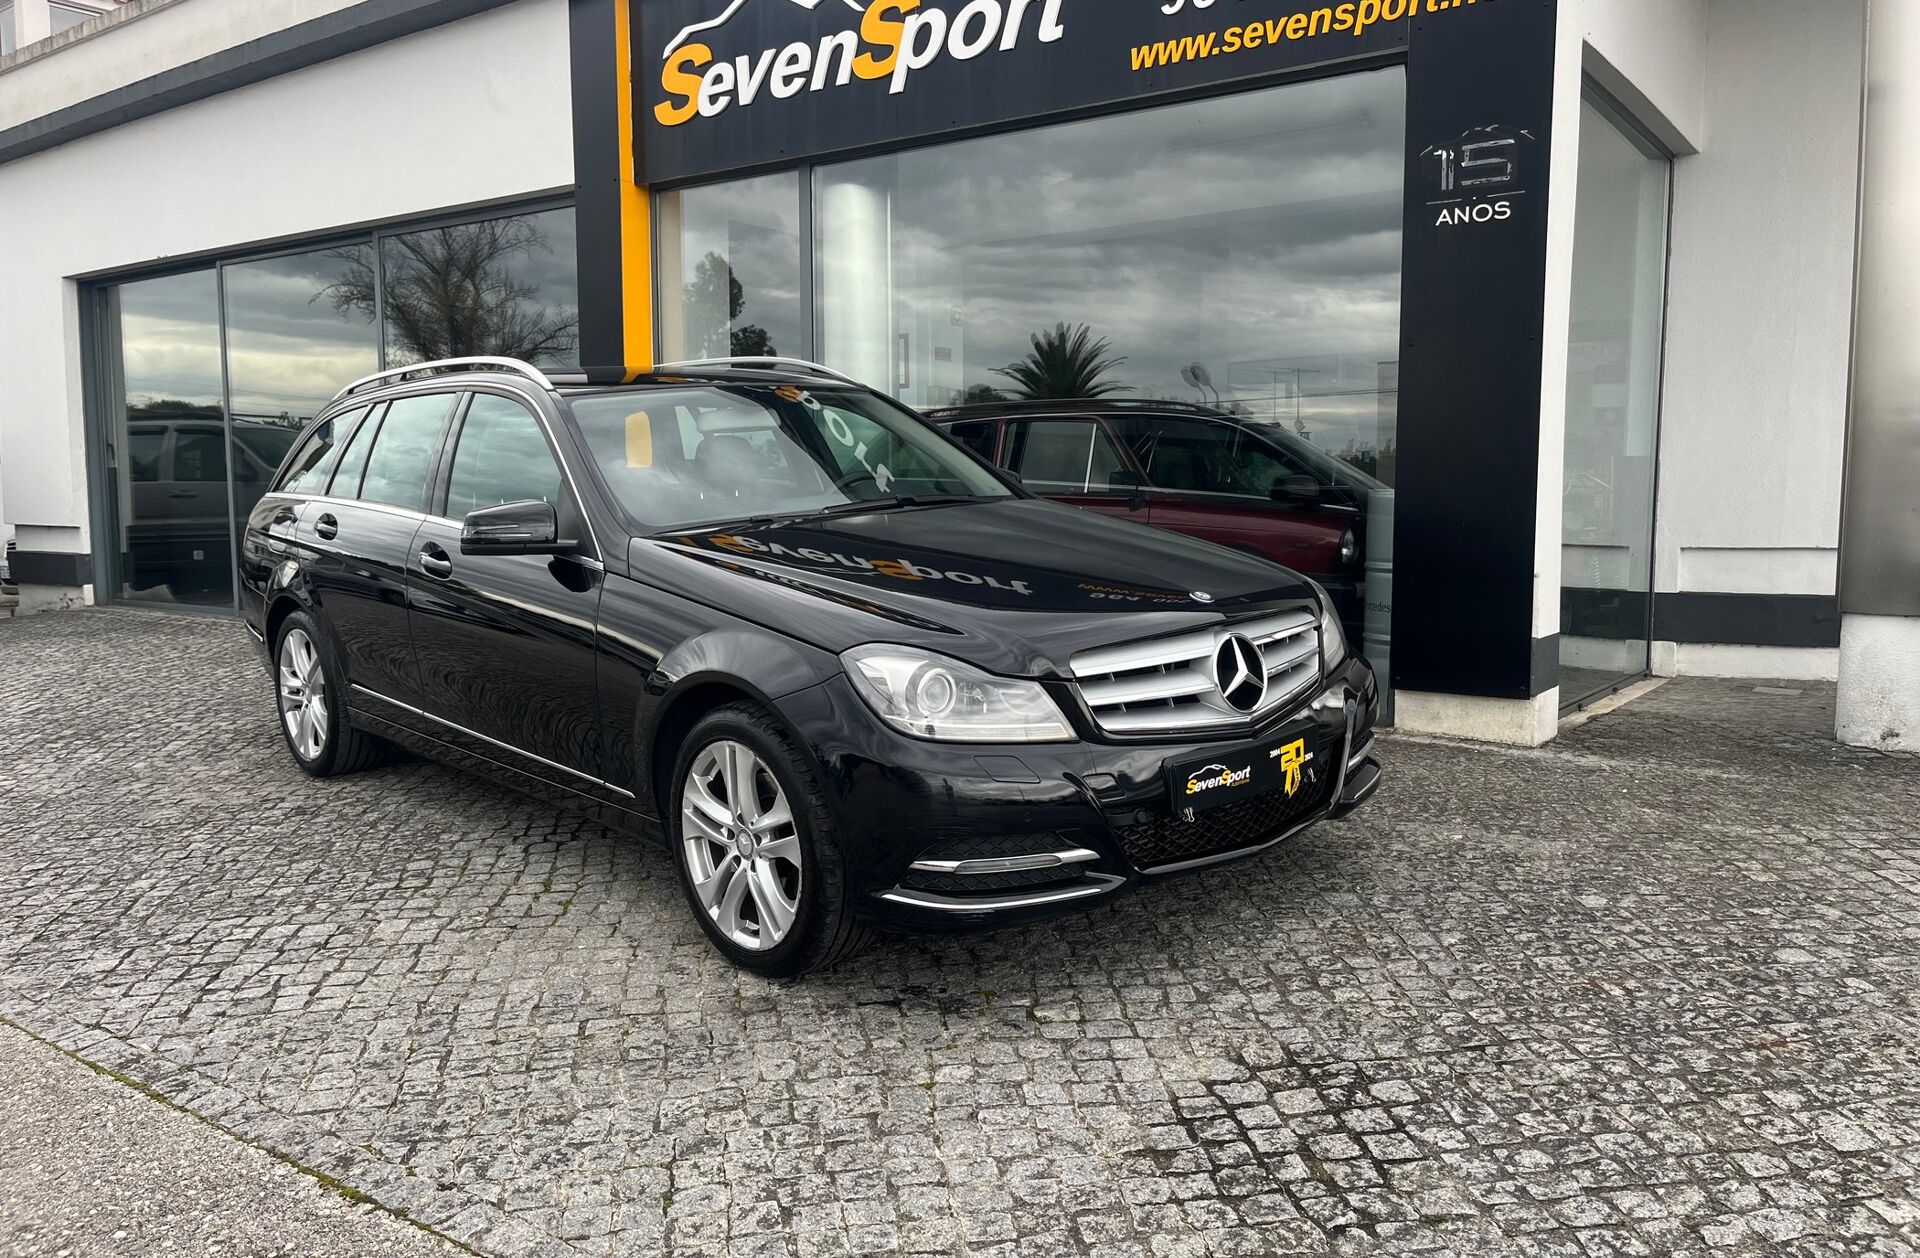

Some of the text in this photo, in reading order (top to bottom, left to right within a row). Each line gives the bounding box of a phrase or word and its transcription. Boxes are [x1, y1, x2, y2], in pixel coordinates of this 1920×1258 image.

[654, 0, 1064, 126] SevenSport
[1433, 139, 1515, 191] 15
[1435, 201, 1511, 226] ANOS
[1186, 765, 1251, 794] SevenSport
